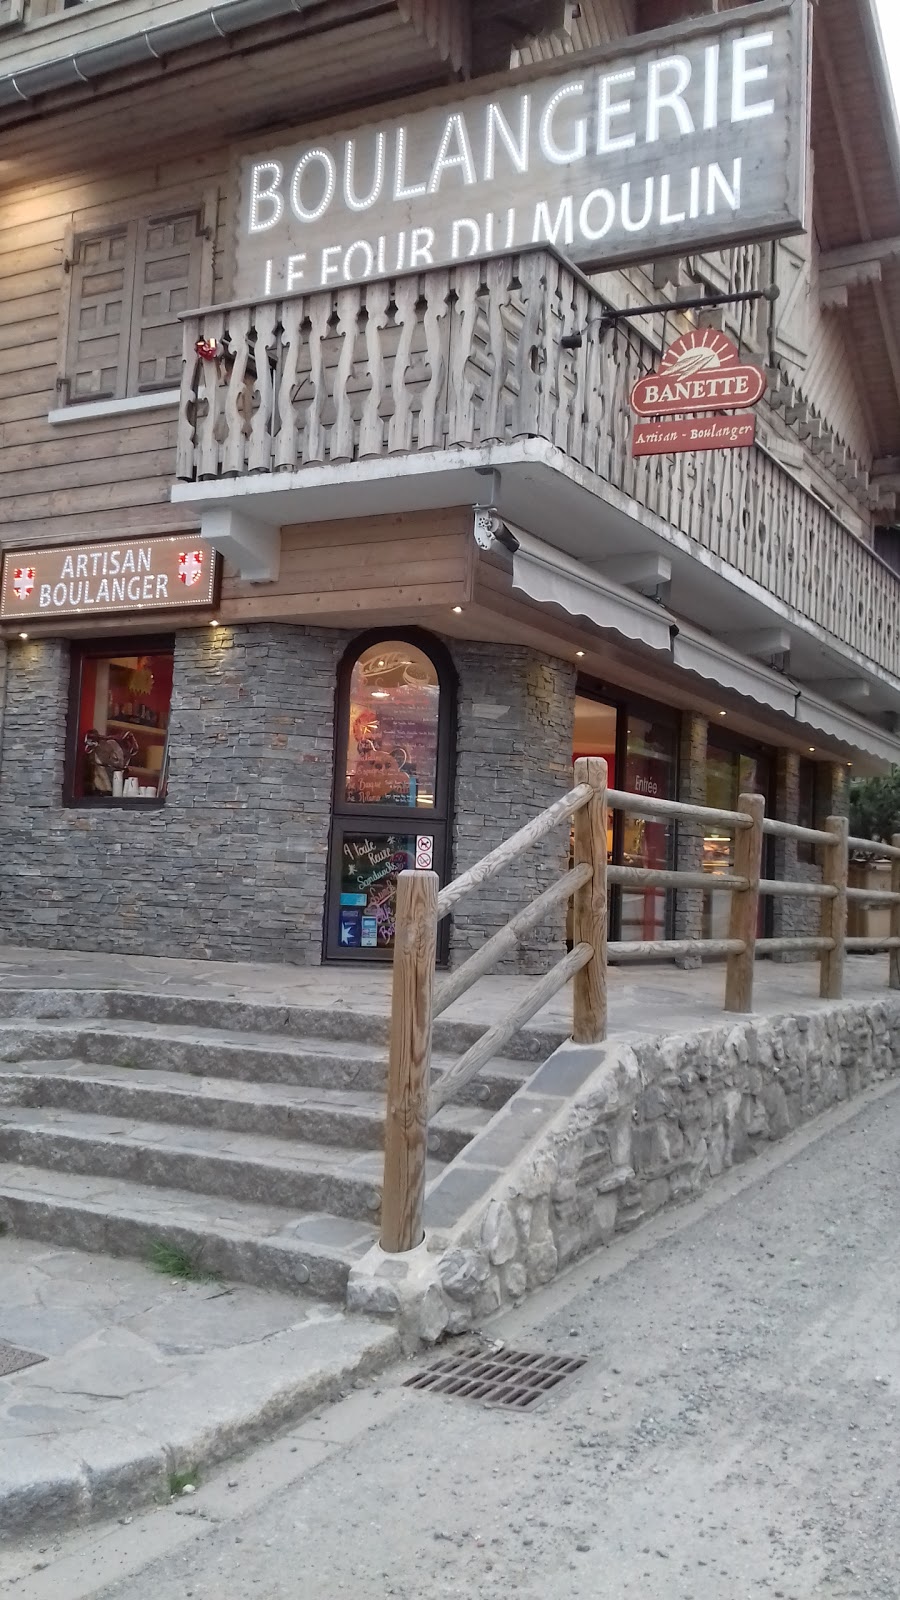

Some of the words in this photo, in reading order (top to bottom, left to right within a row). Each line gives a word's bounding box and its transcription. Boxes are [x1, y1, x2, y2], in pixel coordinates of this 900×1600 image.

[248, 31, 775, 235] BOULANGERIE
[320, 226, 435, 286] FOUR
[451, 207, 516, 259] DU
[532, 157, 742, 246] MOULIN
[643, 376, 749, 404] BANETTE
[635, 427, 678, 444] Artisan
[690, 423, 752, 440] Boulanger
[60, 547, 152, 579] ARTISAN
[39, 573, 169, 608] BOULANGER
[635, 775, 658, 795] Entrée
